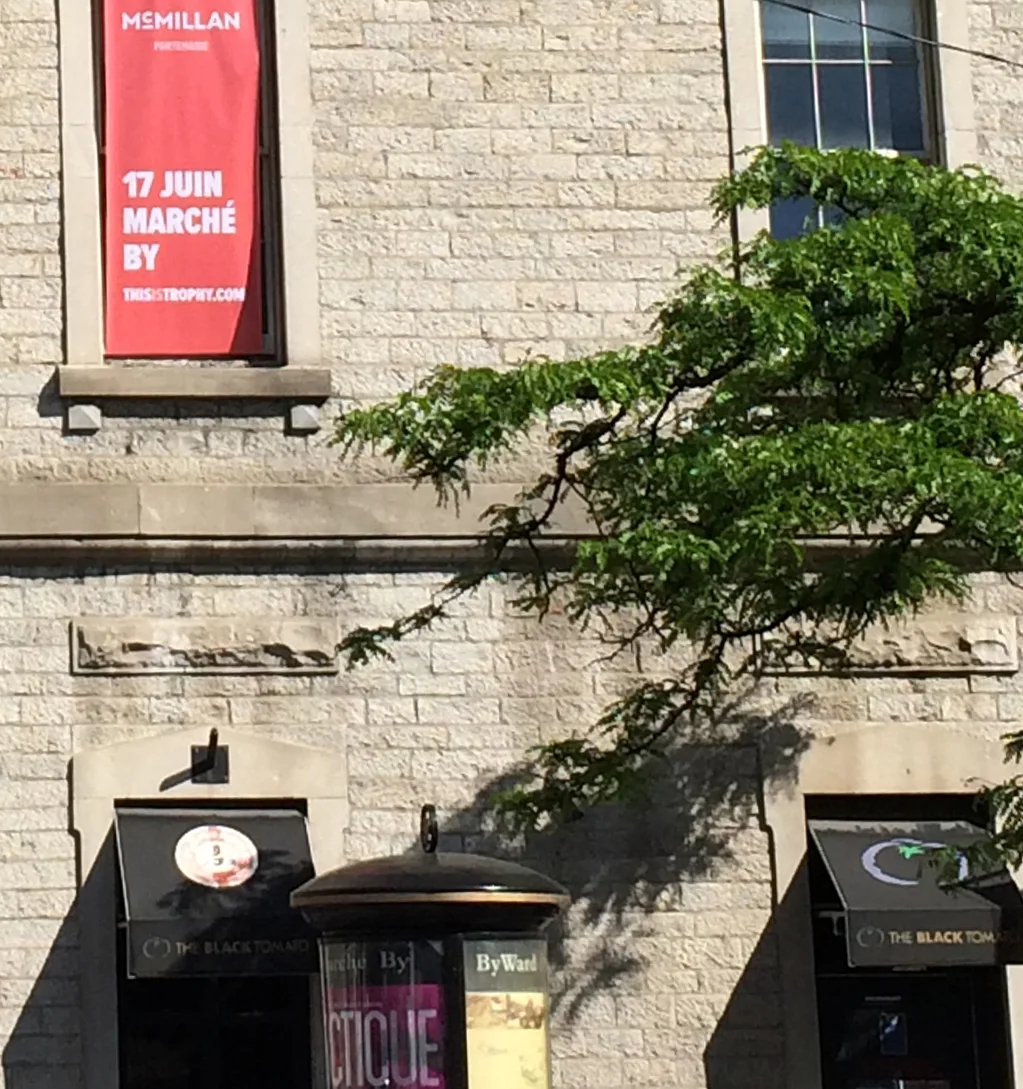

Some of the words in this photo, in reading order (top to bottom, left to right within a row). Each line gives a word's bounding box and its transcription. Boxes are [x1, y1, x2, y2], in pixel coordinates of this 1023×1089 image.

[121, 170, 155, 198] 17
[159, 170, 223, 198] JUIN
[123, 199, 237, 234] MARCHÉ
[123, 243, 161, 271] BY
[204, 939, 251, 955] BLACK
[253, 938, 310, 954] TOMATO
[888, 931, 913, 945] THE
[916, 930, 964, 945] BLACK
